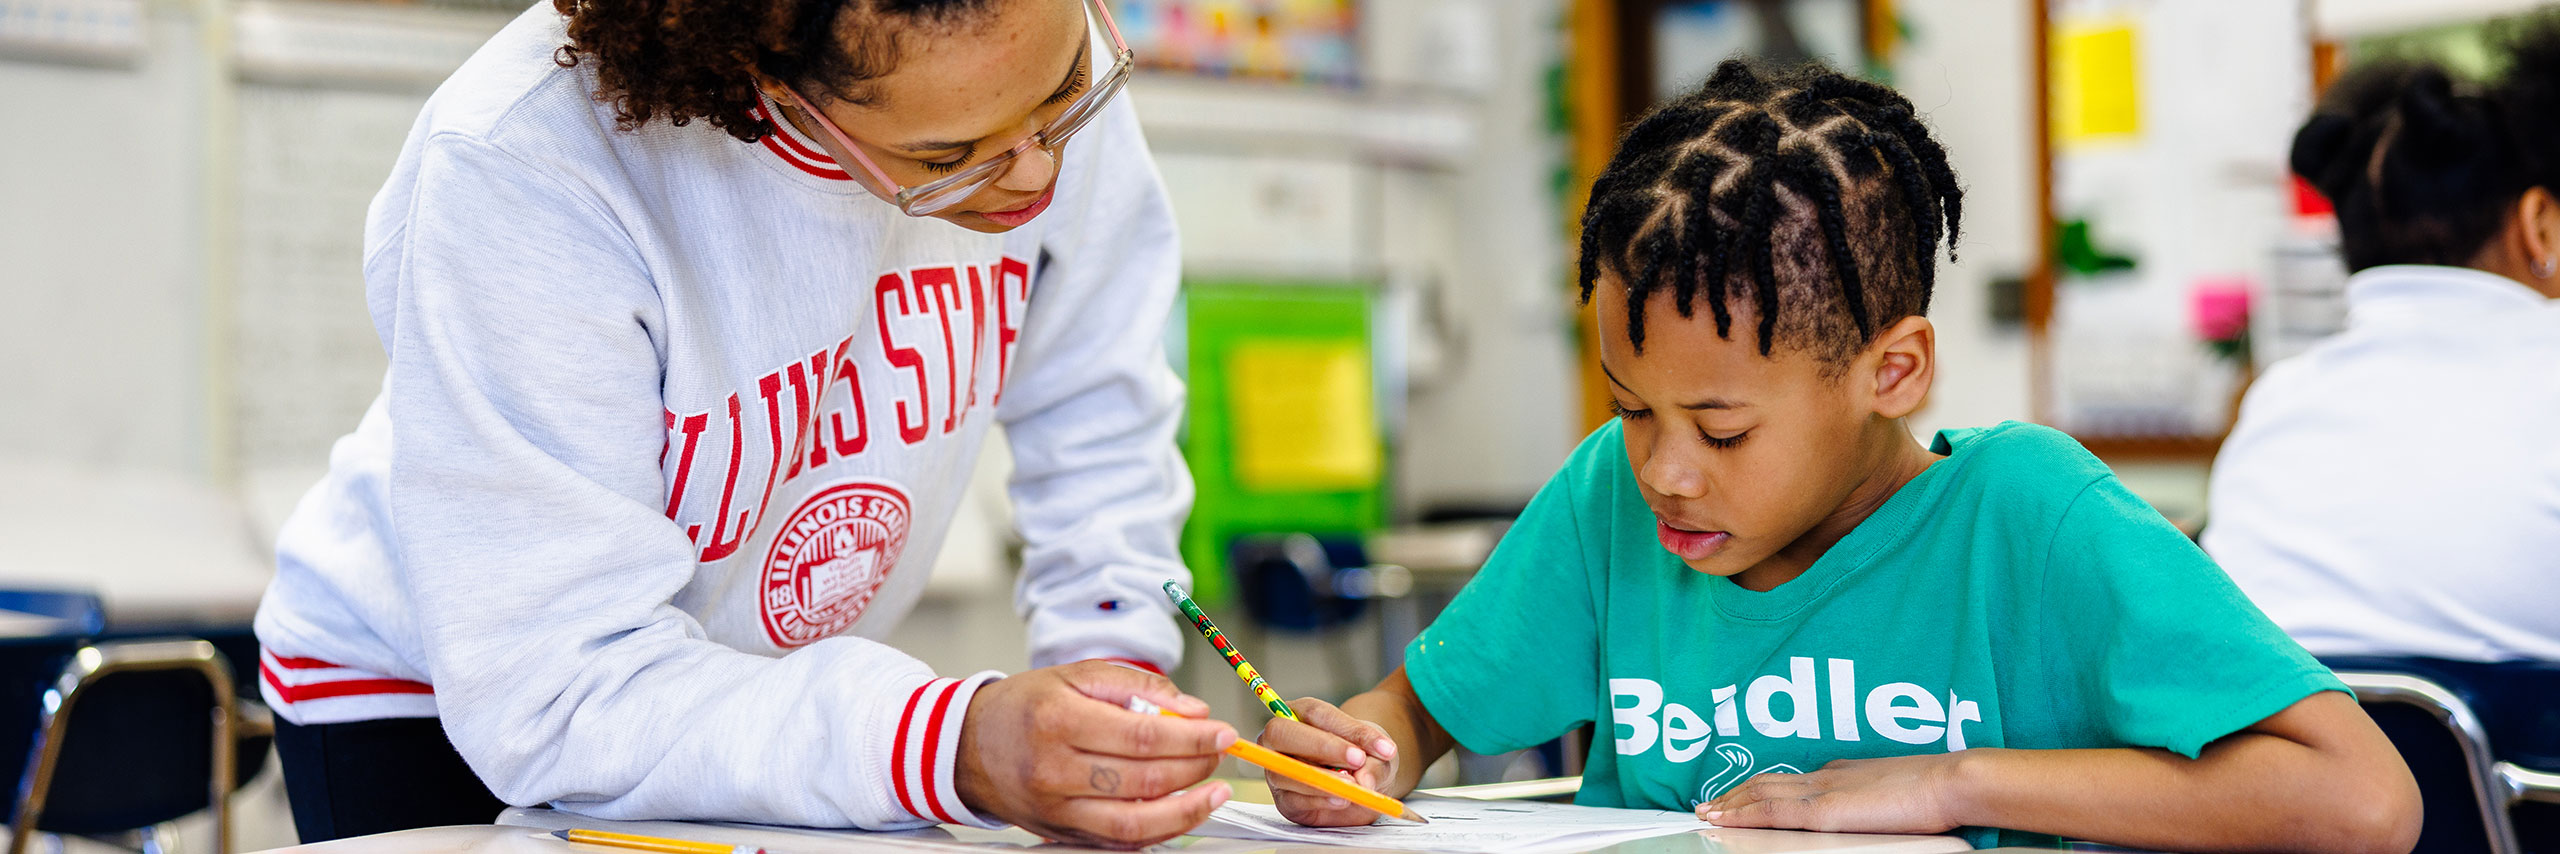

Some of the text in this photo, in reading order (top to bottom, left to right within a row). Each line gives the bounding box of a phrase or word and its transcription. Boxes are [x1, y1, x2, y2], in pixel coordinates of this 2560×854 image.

[659, 256, 1029, 563] LLINIS STAE
[771, 496, 864, 582] ILLINOIS
[770, 585, 792, 609] 18
[1609, 656, 1983, 763] Beidler
